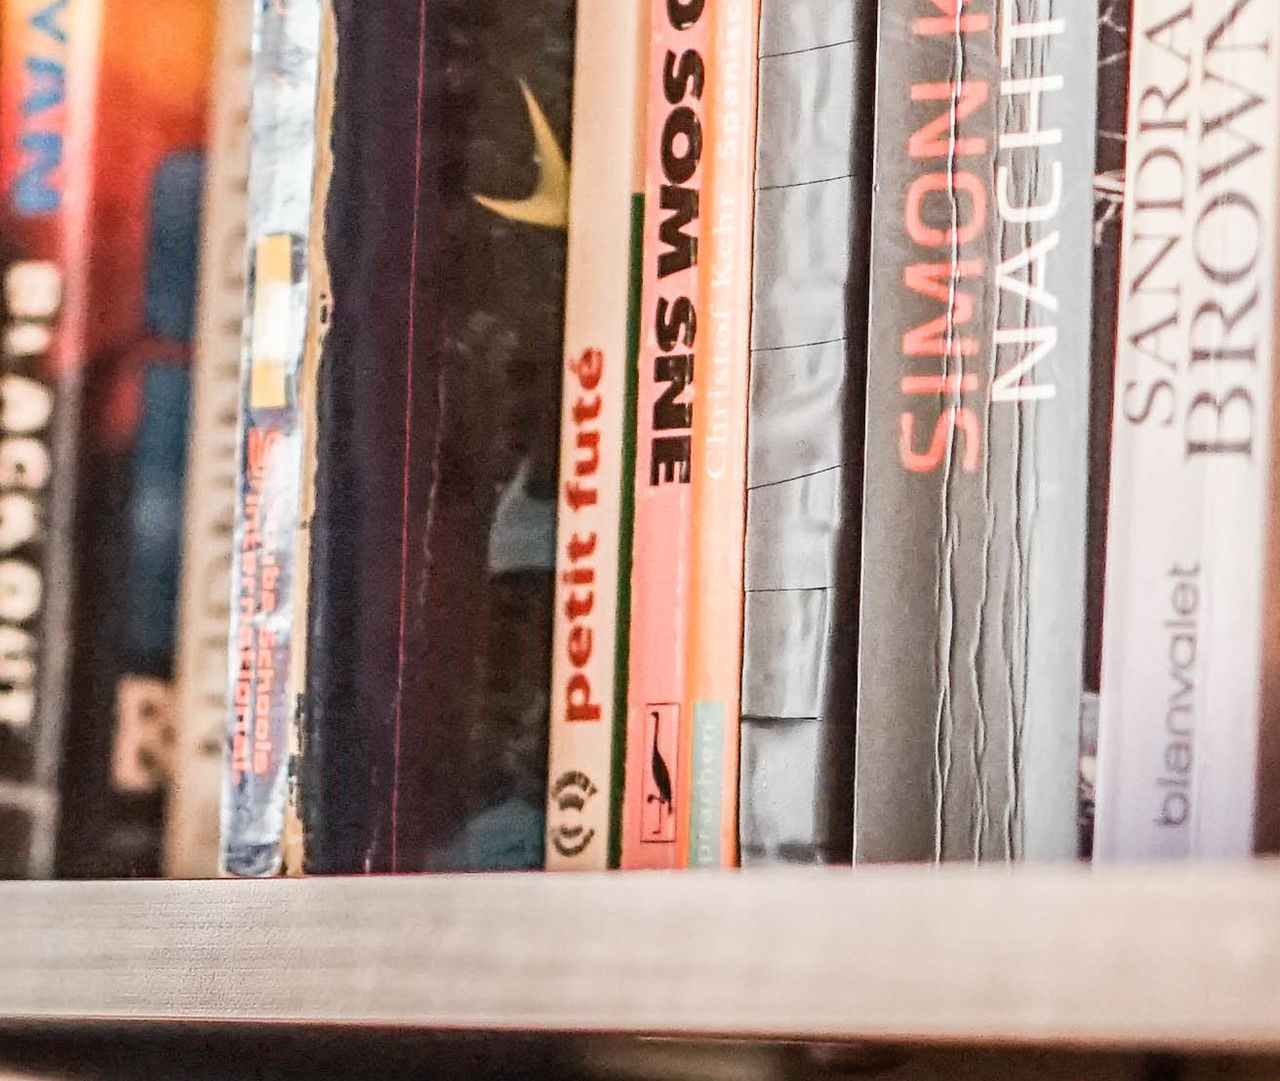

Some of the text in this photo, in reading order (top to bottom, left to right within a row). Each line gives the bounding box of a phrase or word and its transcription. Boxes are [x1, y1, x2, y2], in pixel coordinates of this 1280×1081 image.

[656, 49, 705, 277] SOM
[899, 78, 990, 472] SIMON
[1124, 2, 1194, 426] SANDRA
[650, 297, 697, 486] SNE
[706, 301, 732, 480] Christof
[563, 346, 605, 724] petit futé
[1154, 562, 1201, 829] blanvalet
